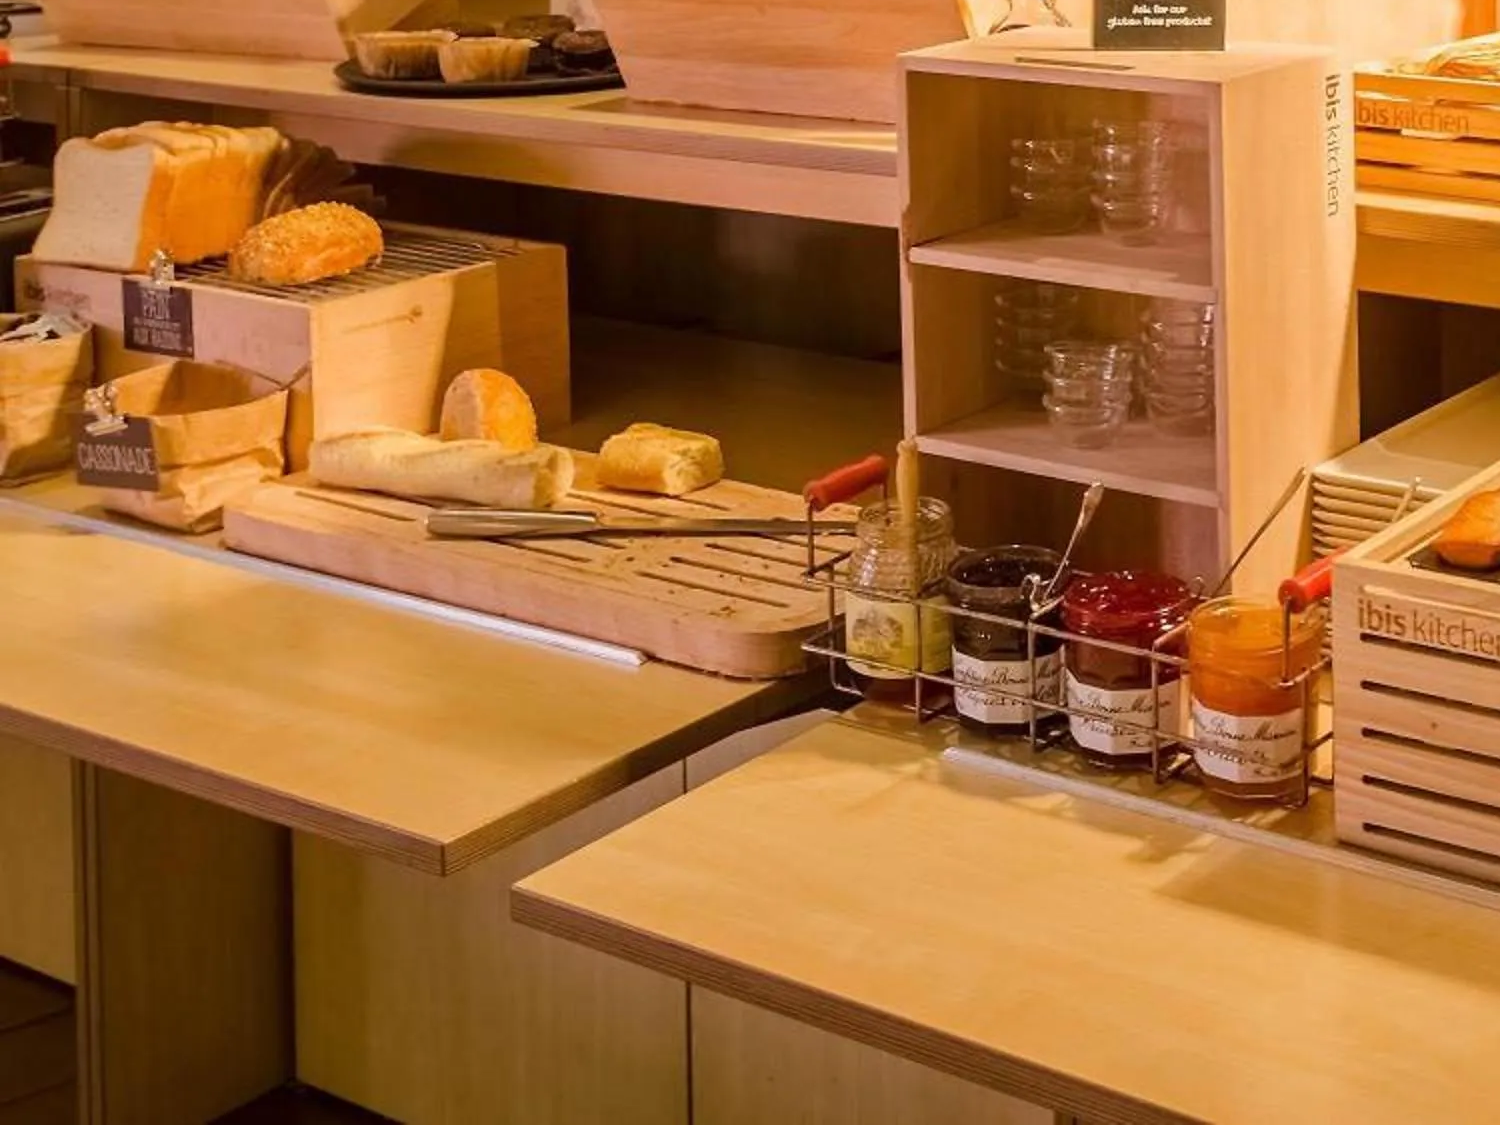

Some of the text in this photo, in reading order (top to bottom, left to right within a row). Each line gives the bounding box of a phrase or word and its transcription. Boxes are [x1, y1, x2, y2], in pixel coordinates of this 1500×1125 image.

[1357, 101, 1470, 133] bis kitchen
[1325, 74, 1341, 217] ibis kitchen
[78, 442, 156, 475] CASSONADE
[1357, 598, 1406, 635] ibis
